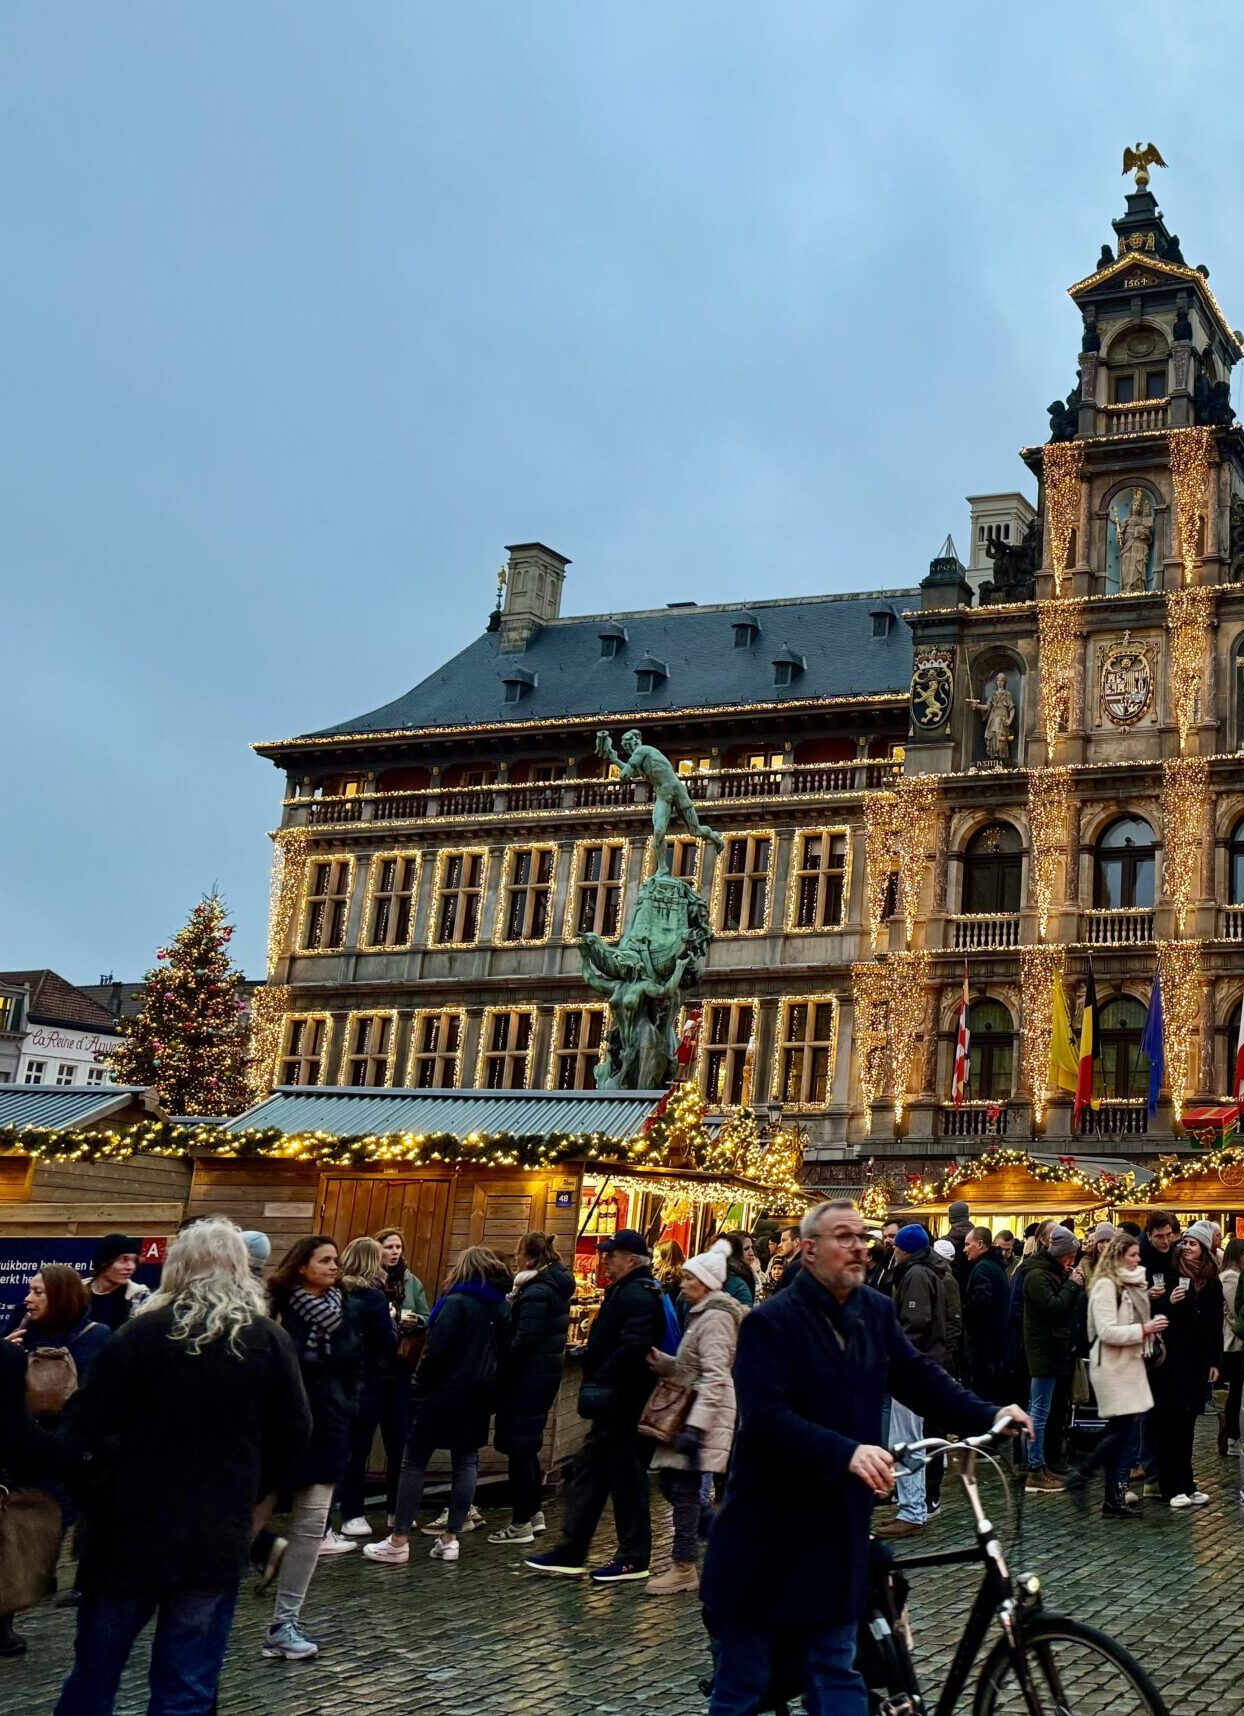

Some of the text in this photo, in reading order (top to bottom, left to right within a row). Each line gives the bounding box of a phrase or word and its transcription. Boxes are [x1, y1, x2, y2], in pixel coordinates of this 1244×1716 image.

[1124, 277, 1148, 288] 1564
[558, 1194, 569, 1202] 48
[146, 1243, 159, 1258] A
[74, 1262, 87, 1271] en
